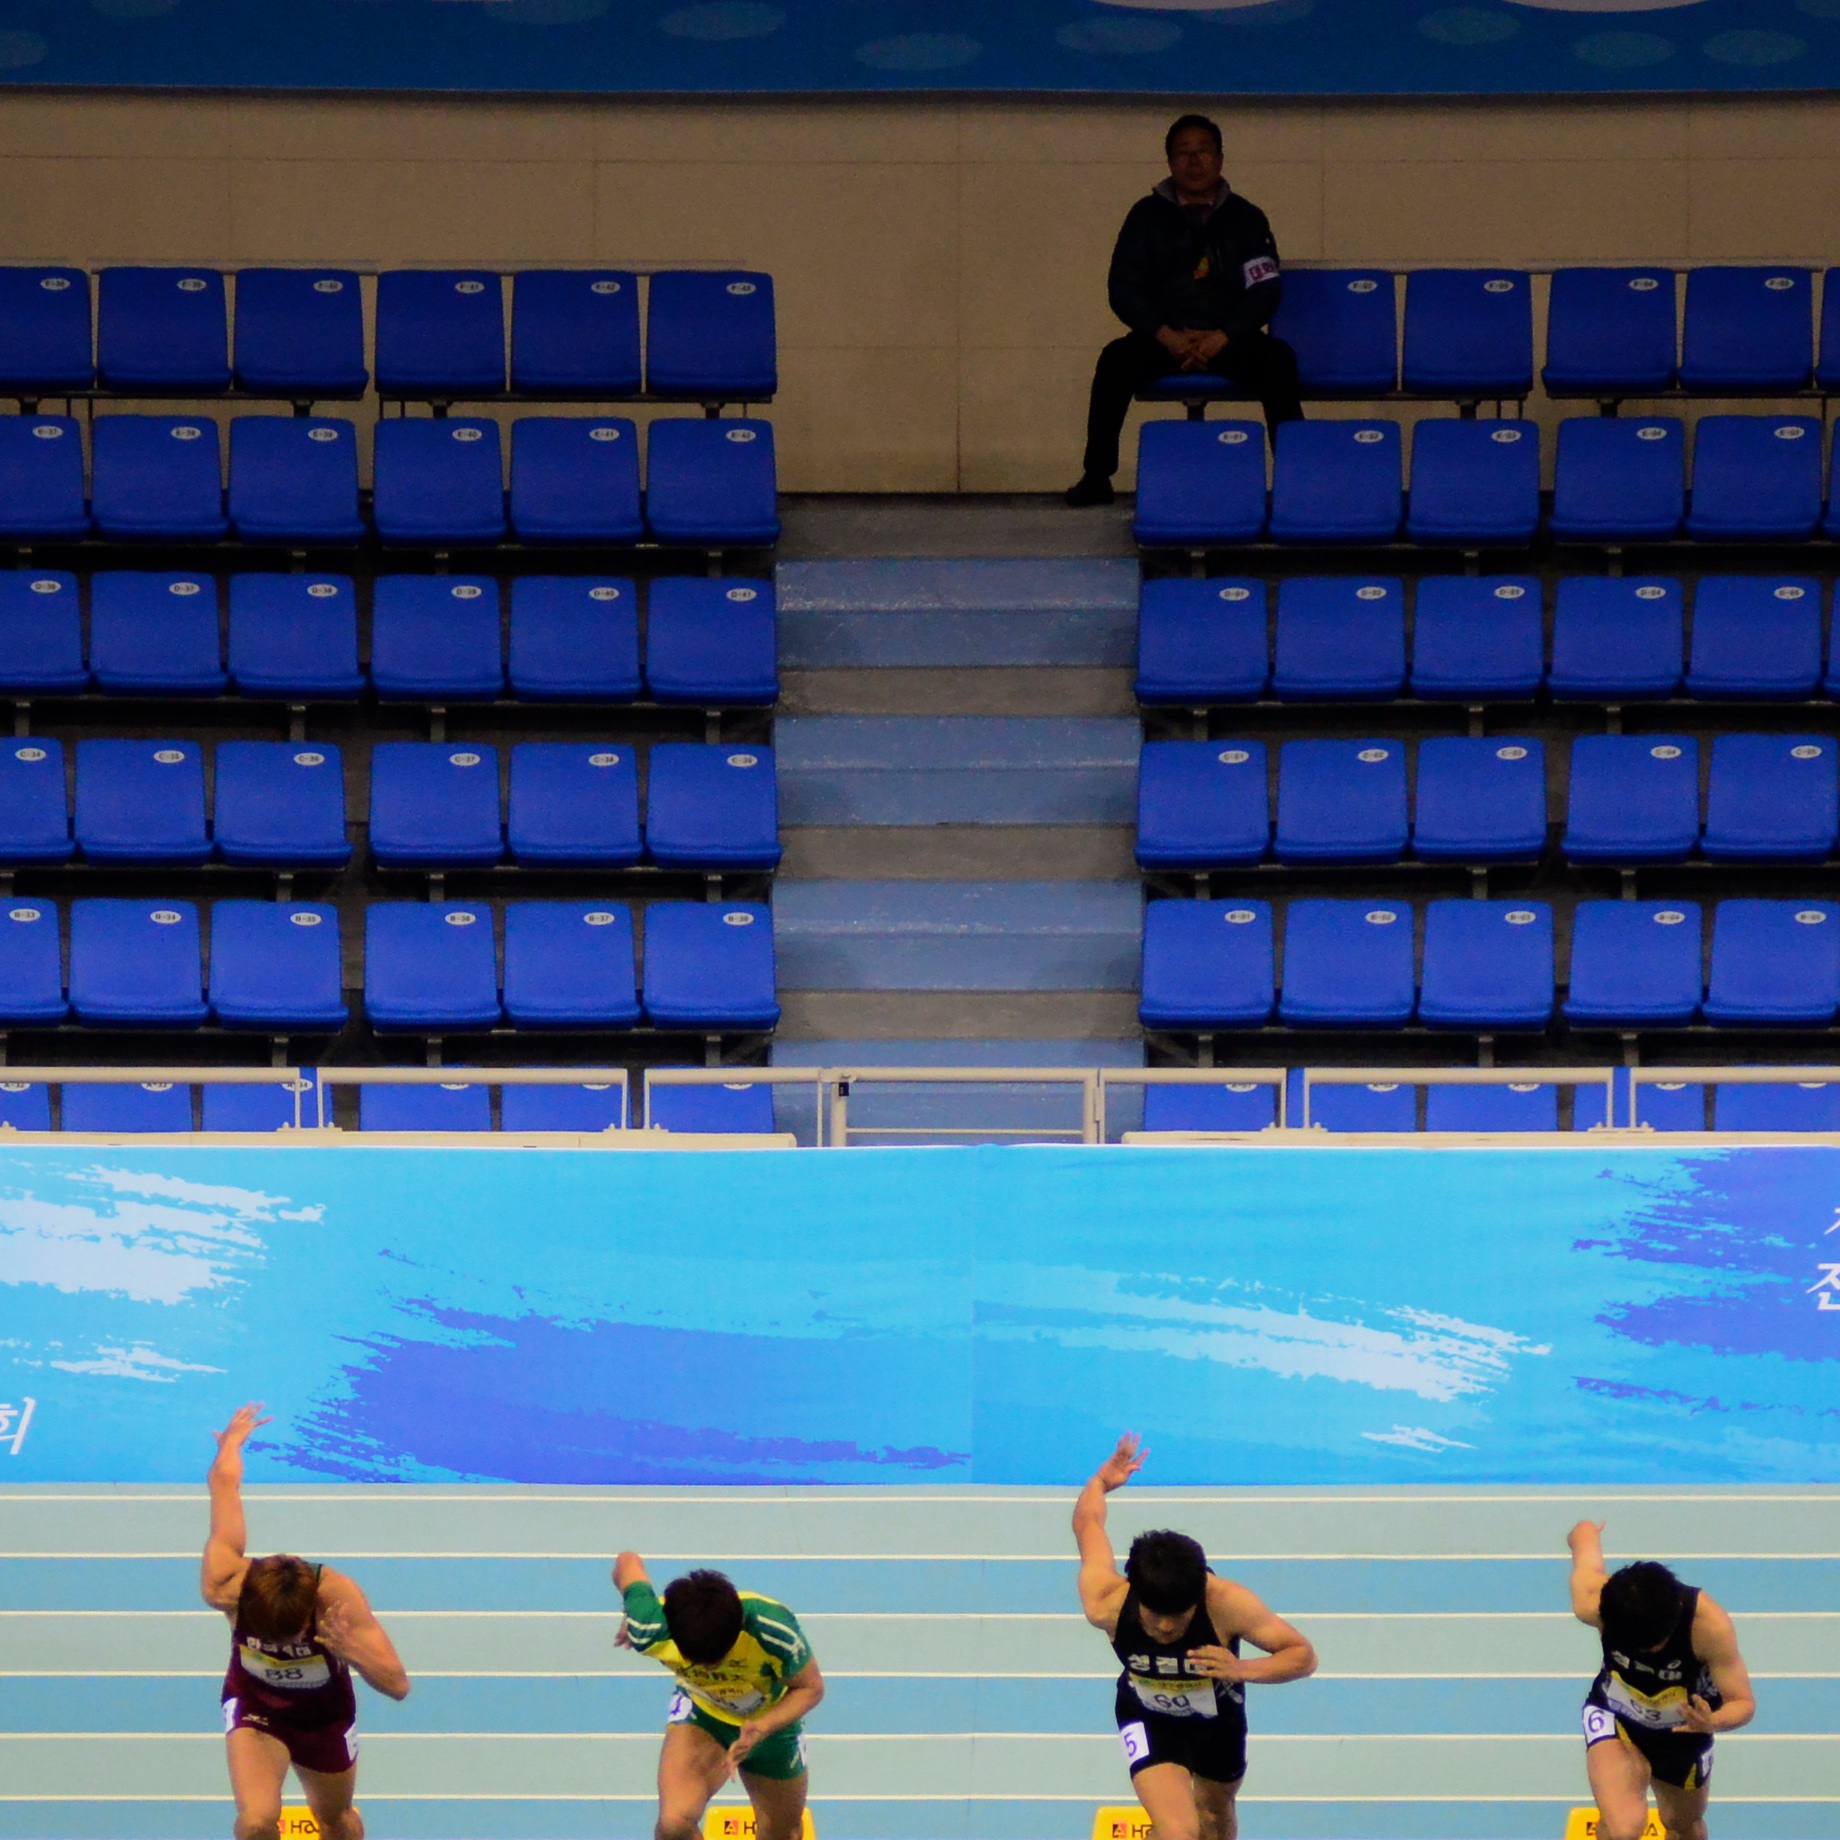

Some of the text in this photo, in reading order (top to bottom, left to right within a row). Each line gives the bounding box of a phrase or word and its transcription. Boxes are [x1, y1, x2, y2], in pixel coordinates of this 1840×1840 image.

[265, 1667, 304, 1681] 88
[1153, 1693, 1191, 1709] 60
[1629, 1698, 1662, 1722] 63
[1587, 1709, 1606, 1735] 6
[1123, 1731, 1138, 1758] 5
